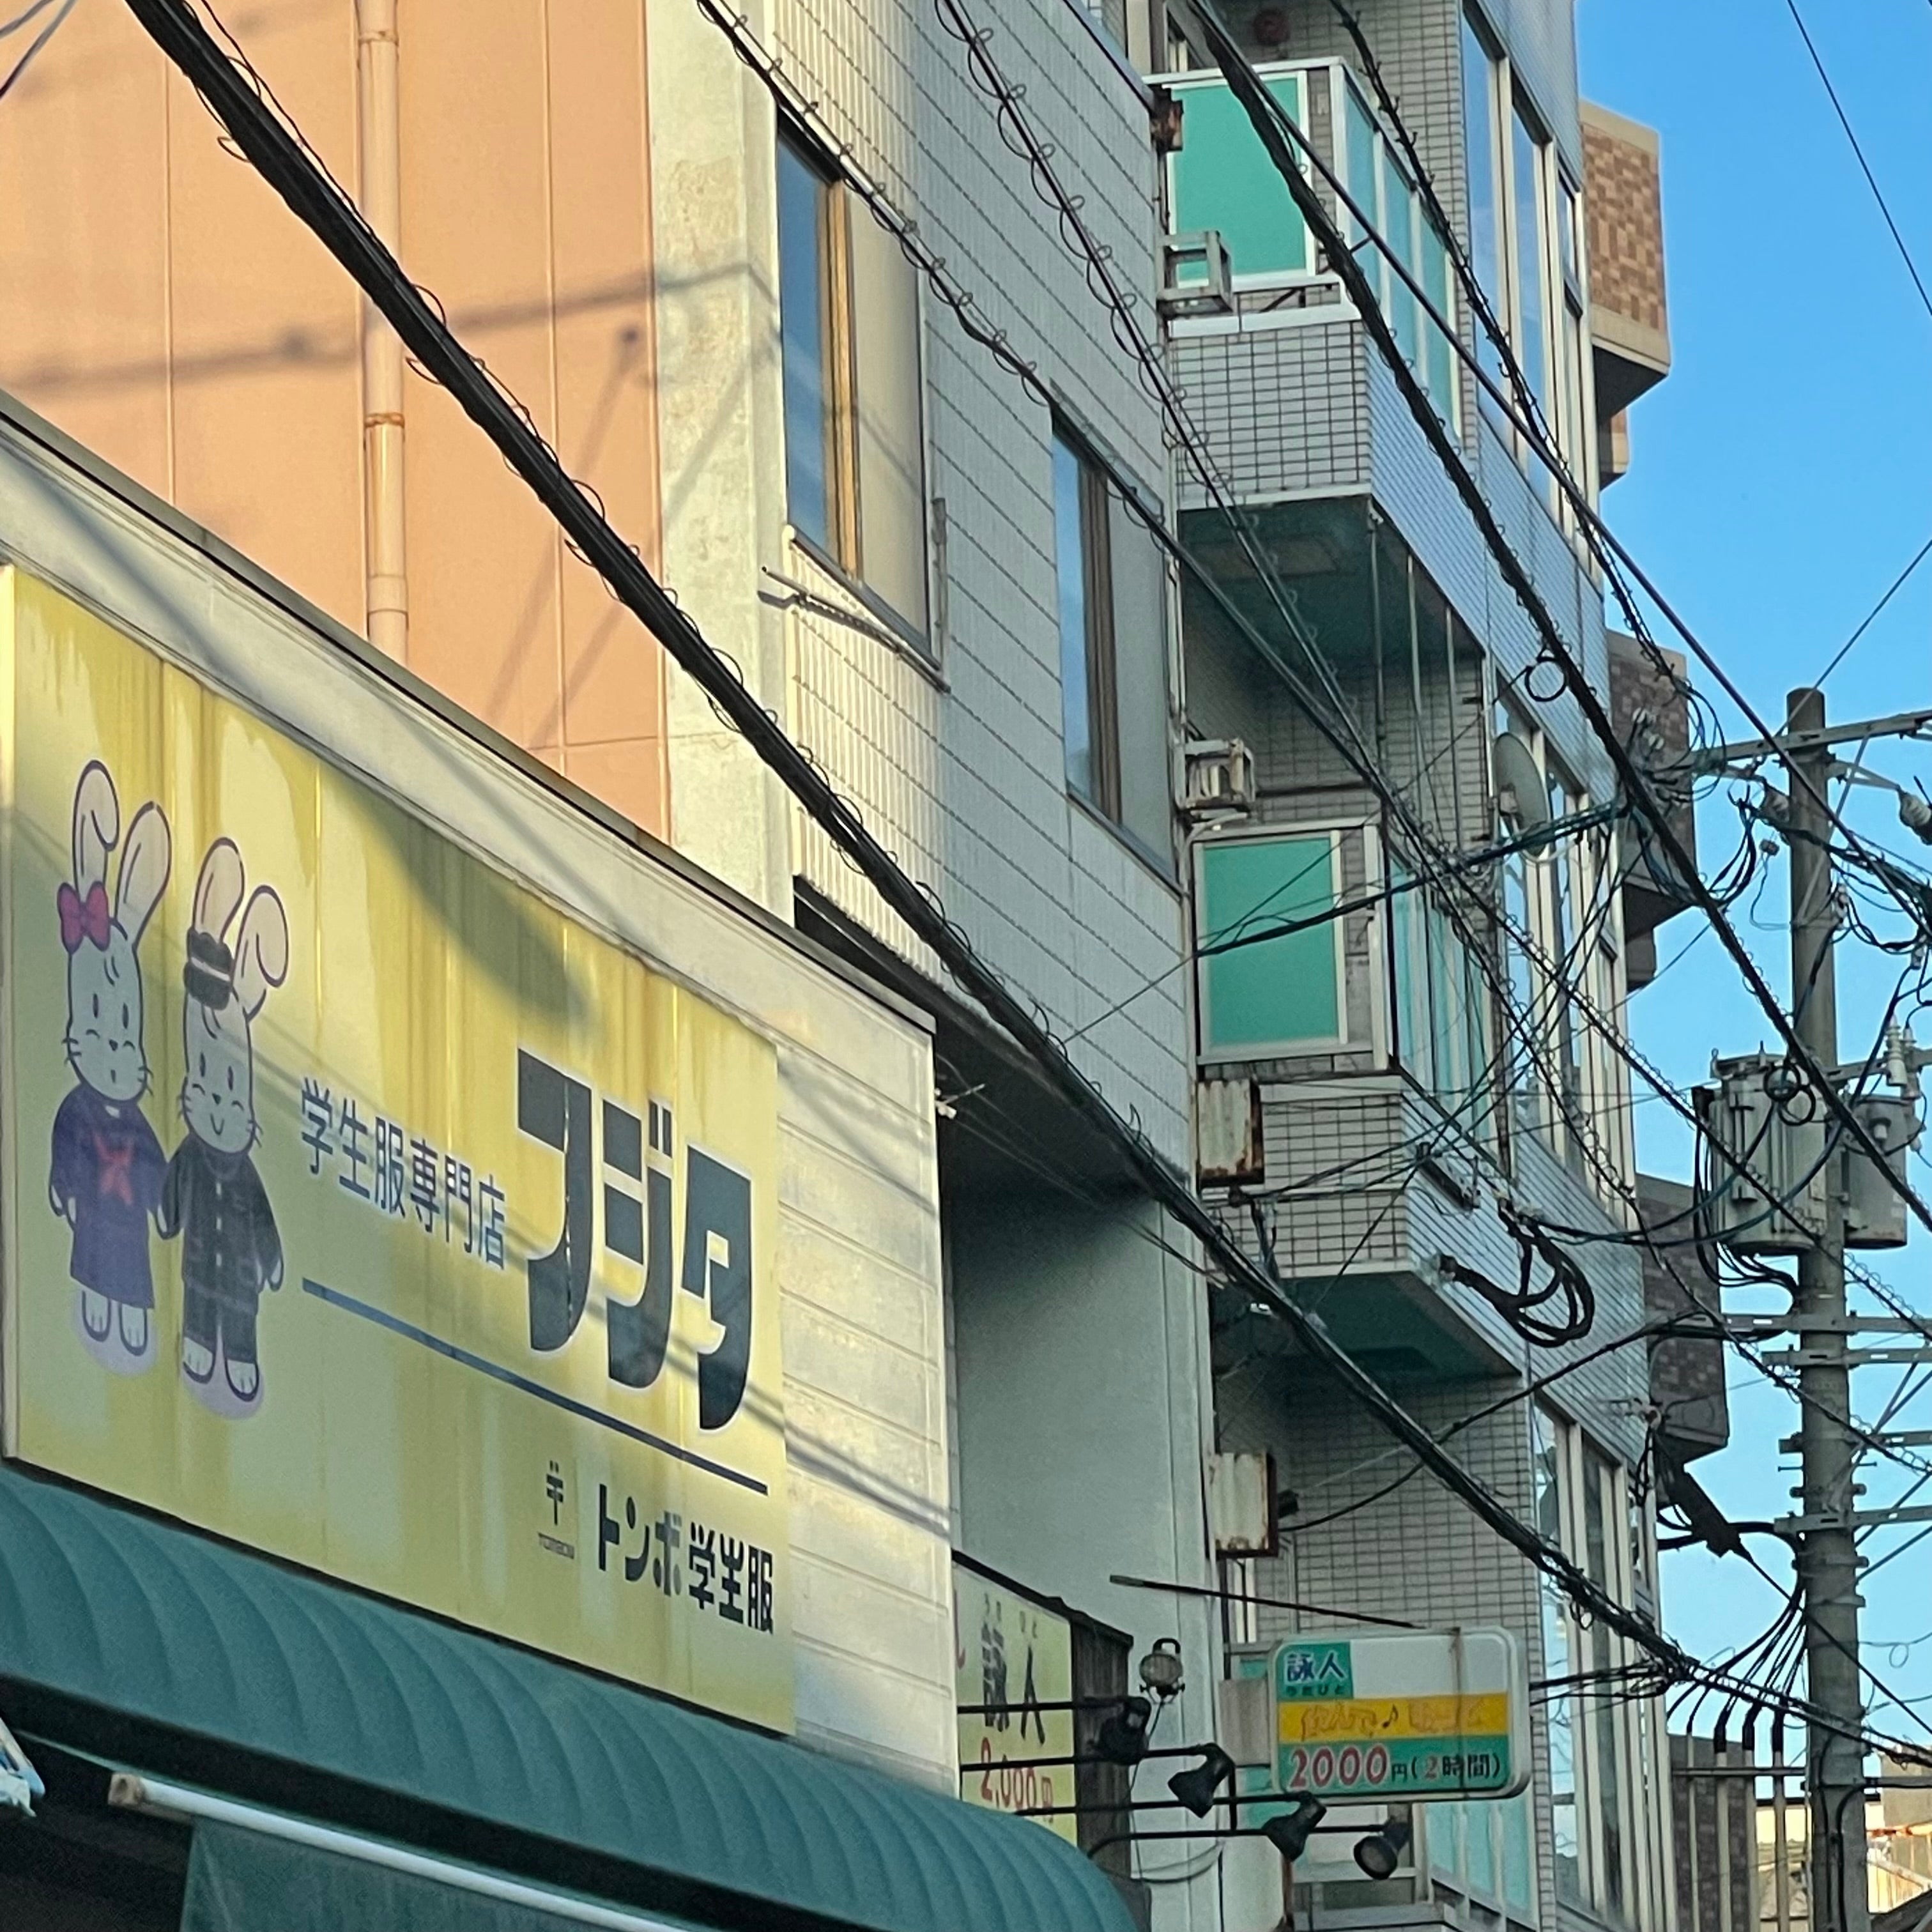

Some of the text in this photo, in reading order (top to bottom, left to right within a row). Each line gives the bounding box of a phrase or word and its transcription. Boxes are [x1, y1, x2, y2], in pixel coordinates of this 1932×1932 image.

[302, 1077, 505, 1270] 学生服専門店
[518, 1048, 752, 1430] フジタ
[599, 1483, 773, 1634] トンボ学生服
